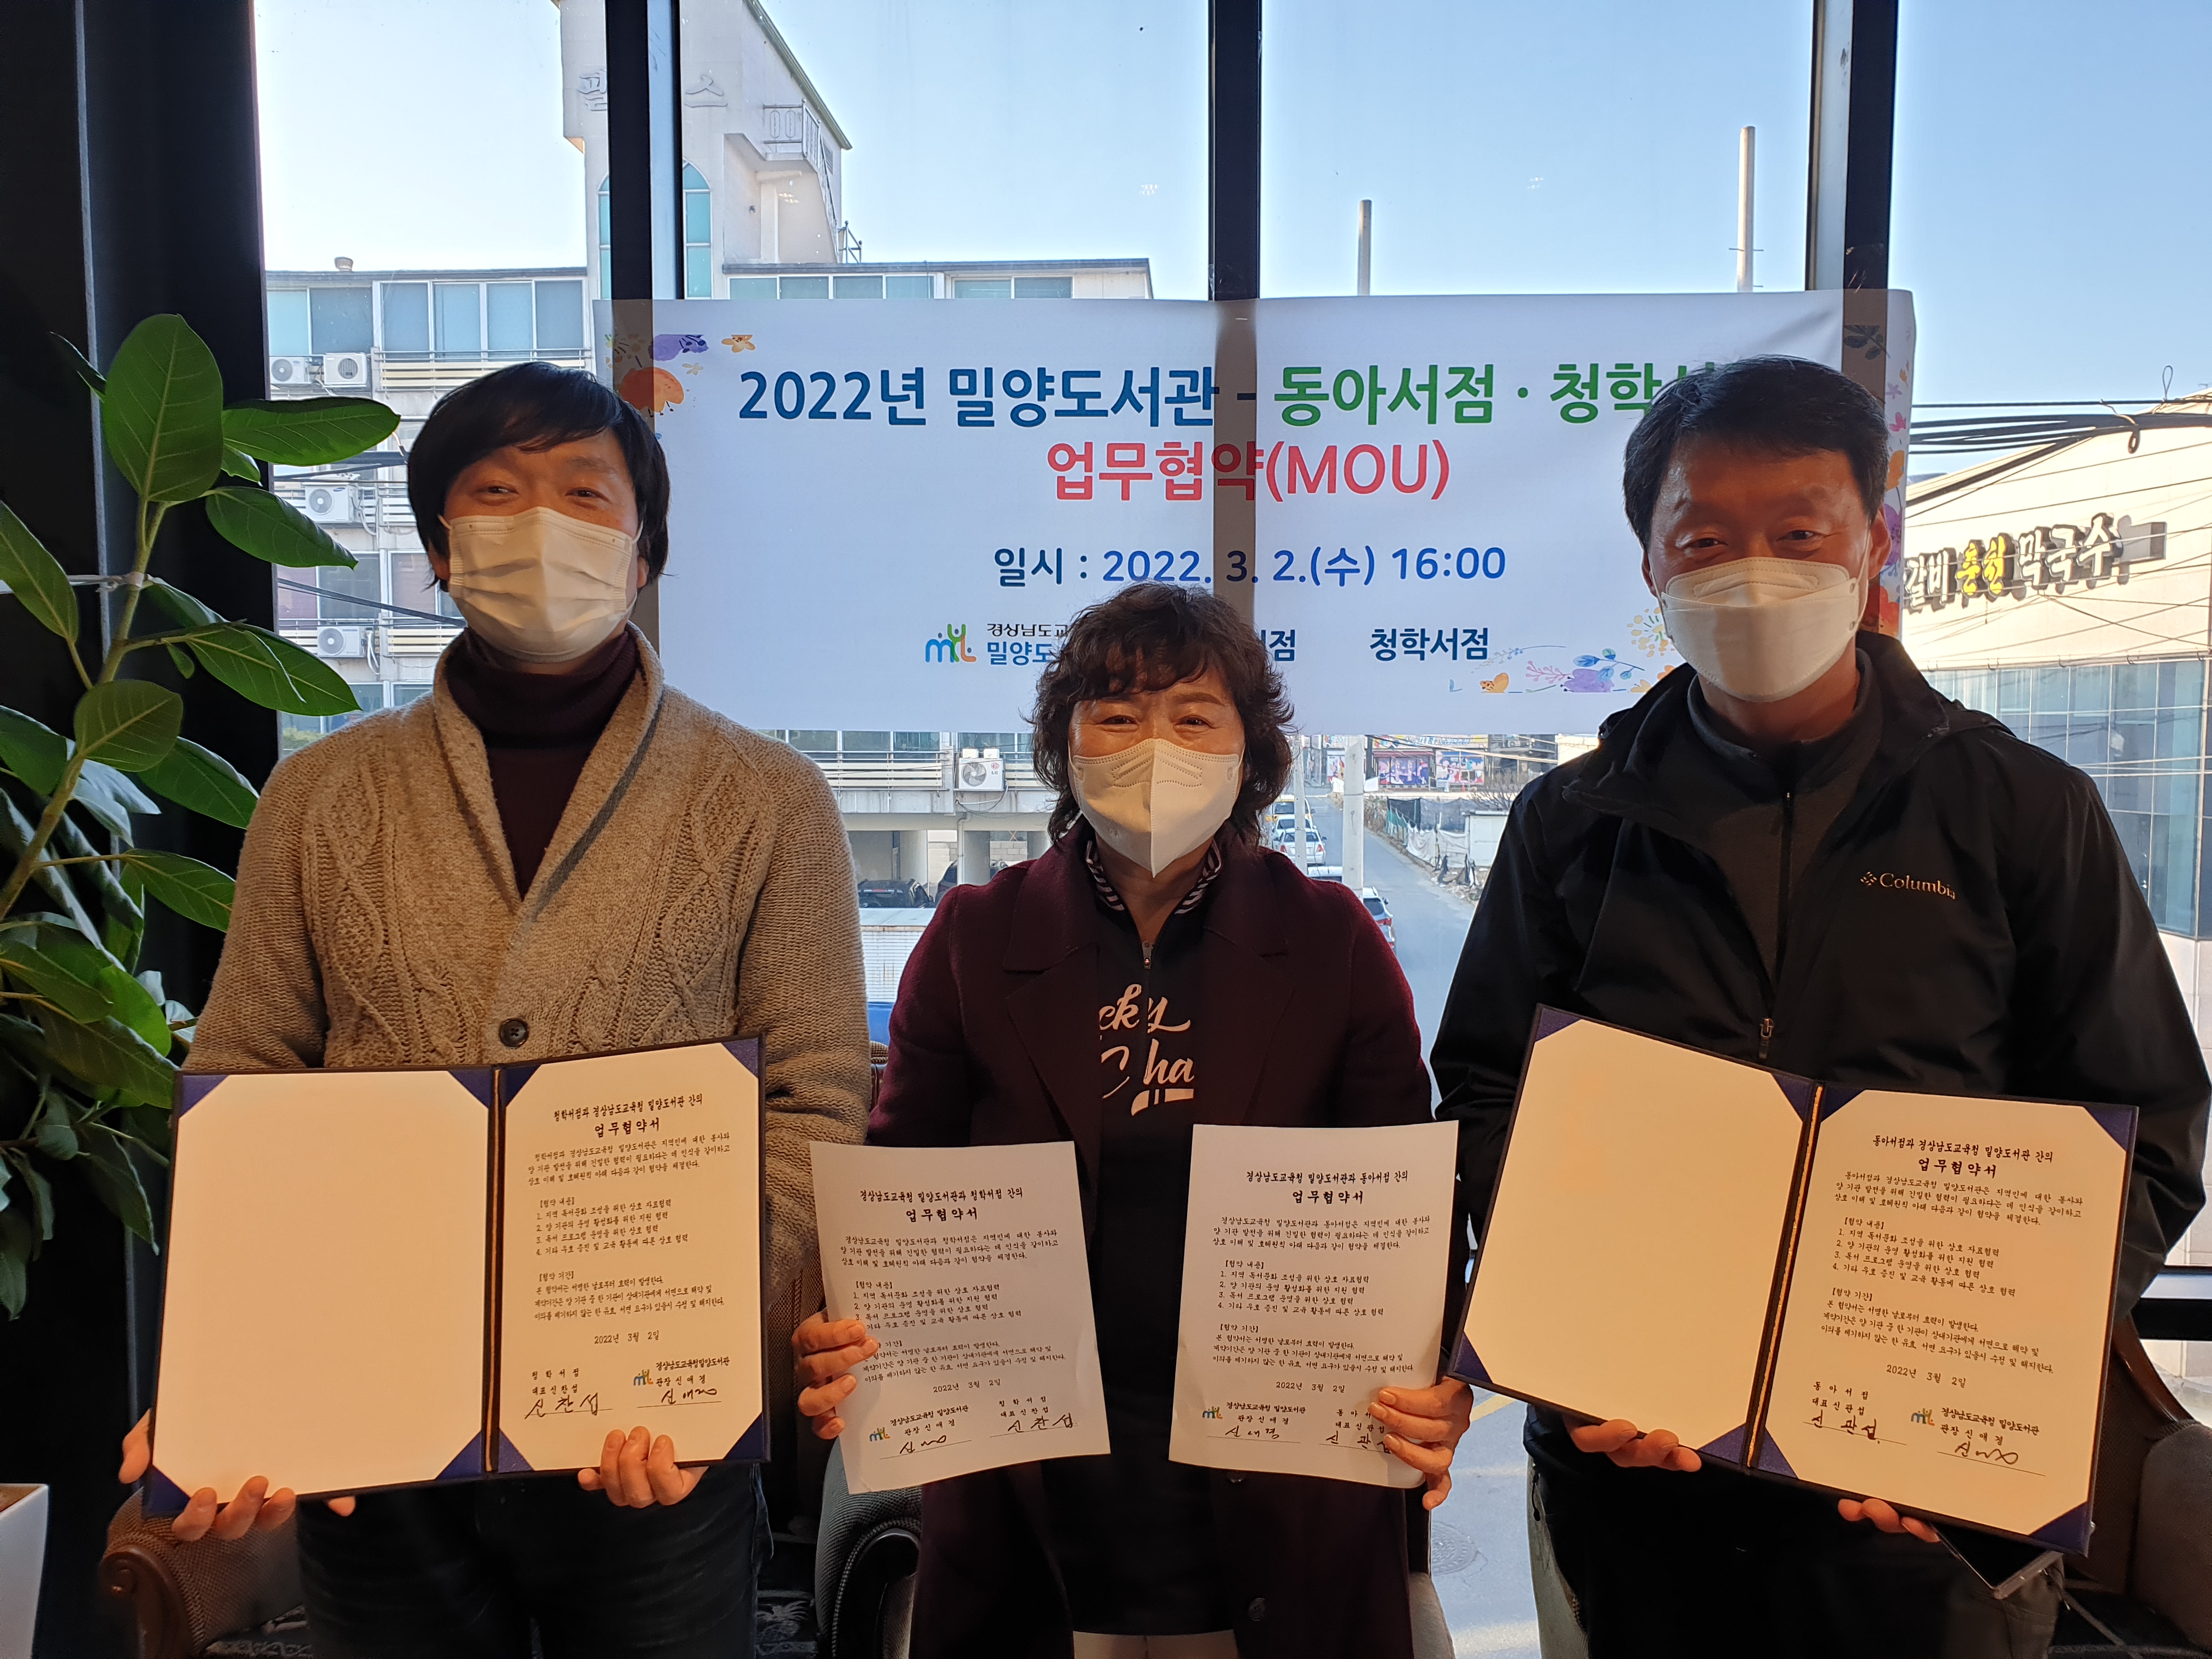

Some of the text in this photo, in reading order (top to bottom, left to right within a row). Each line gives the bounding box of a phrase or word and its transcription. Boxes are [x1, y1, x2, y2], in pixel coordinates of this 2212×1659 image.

[739, 366, 927, 426] 2022년
[947, 366, 1221, 428] 밀양도서관
[1274, 363, 1495, 426] 동아서점
[1550, 362, 1714, 424] 청학
[1047, 439, 1450, 503] 업무협약(MOU)
[994, 548, 1063, 587] 일시
[1102, 550, 1212, 584] 2022.
[1226, 550, 1259, 584] 3.
[1273, 546, 1375, 588] 2.(수)
[1391, 546, 1507, 580] 16:00
[1904, 514, 2115, 606] 갈비 춘천 막국수
[987, 623, 1069, 637] 경상남도교
[1369, 627, 1490, 662] 청학서점
[987, 641, 1057, 666] 밀양도
[1879, 873, 1956, 900] Columbia
